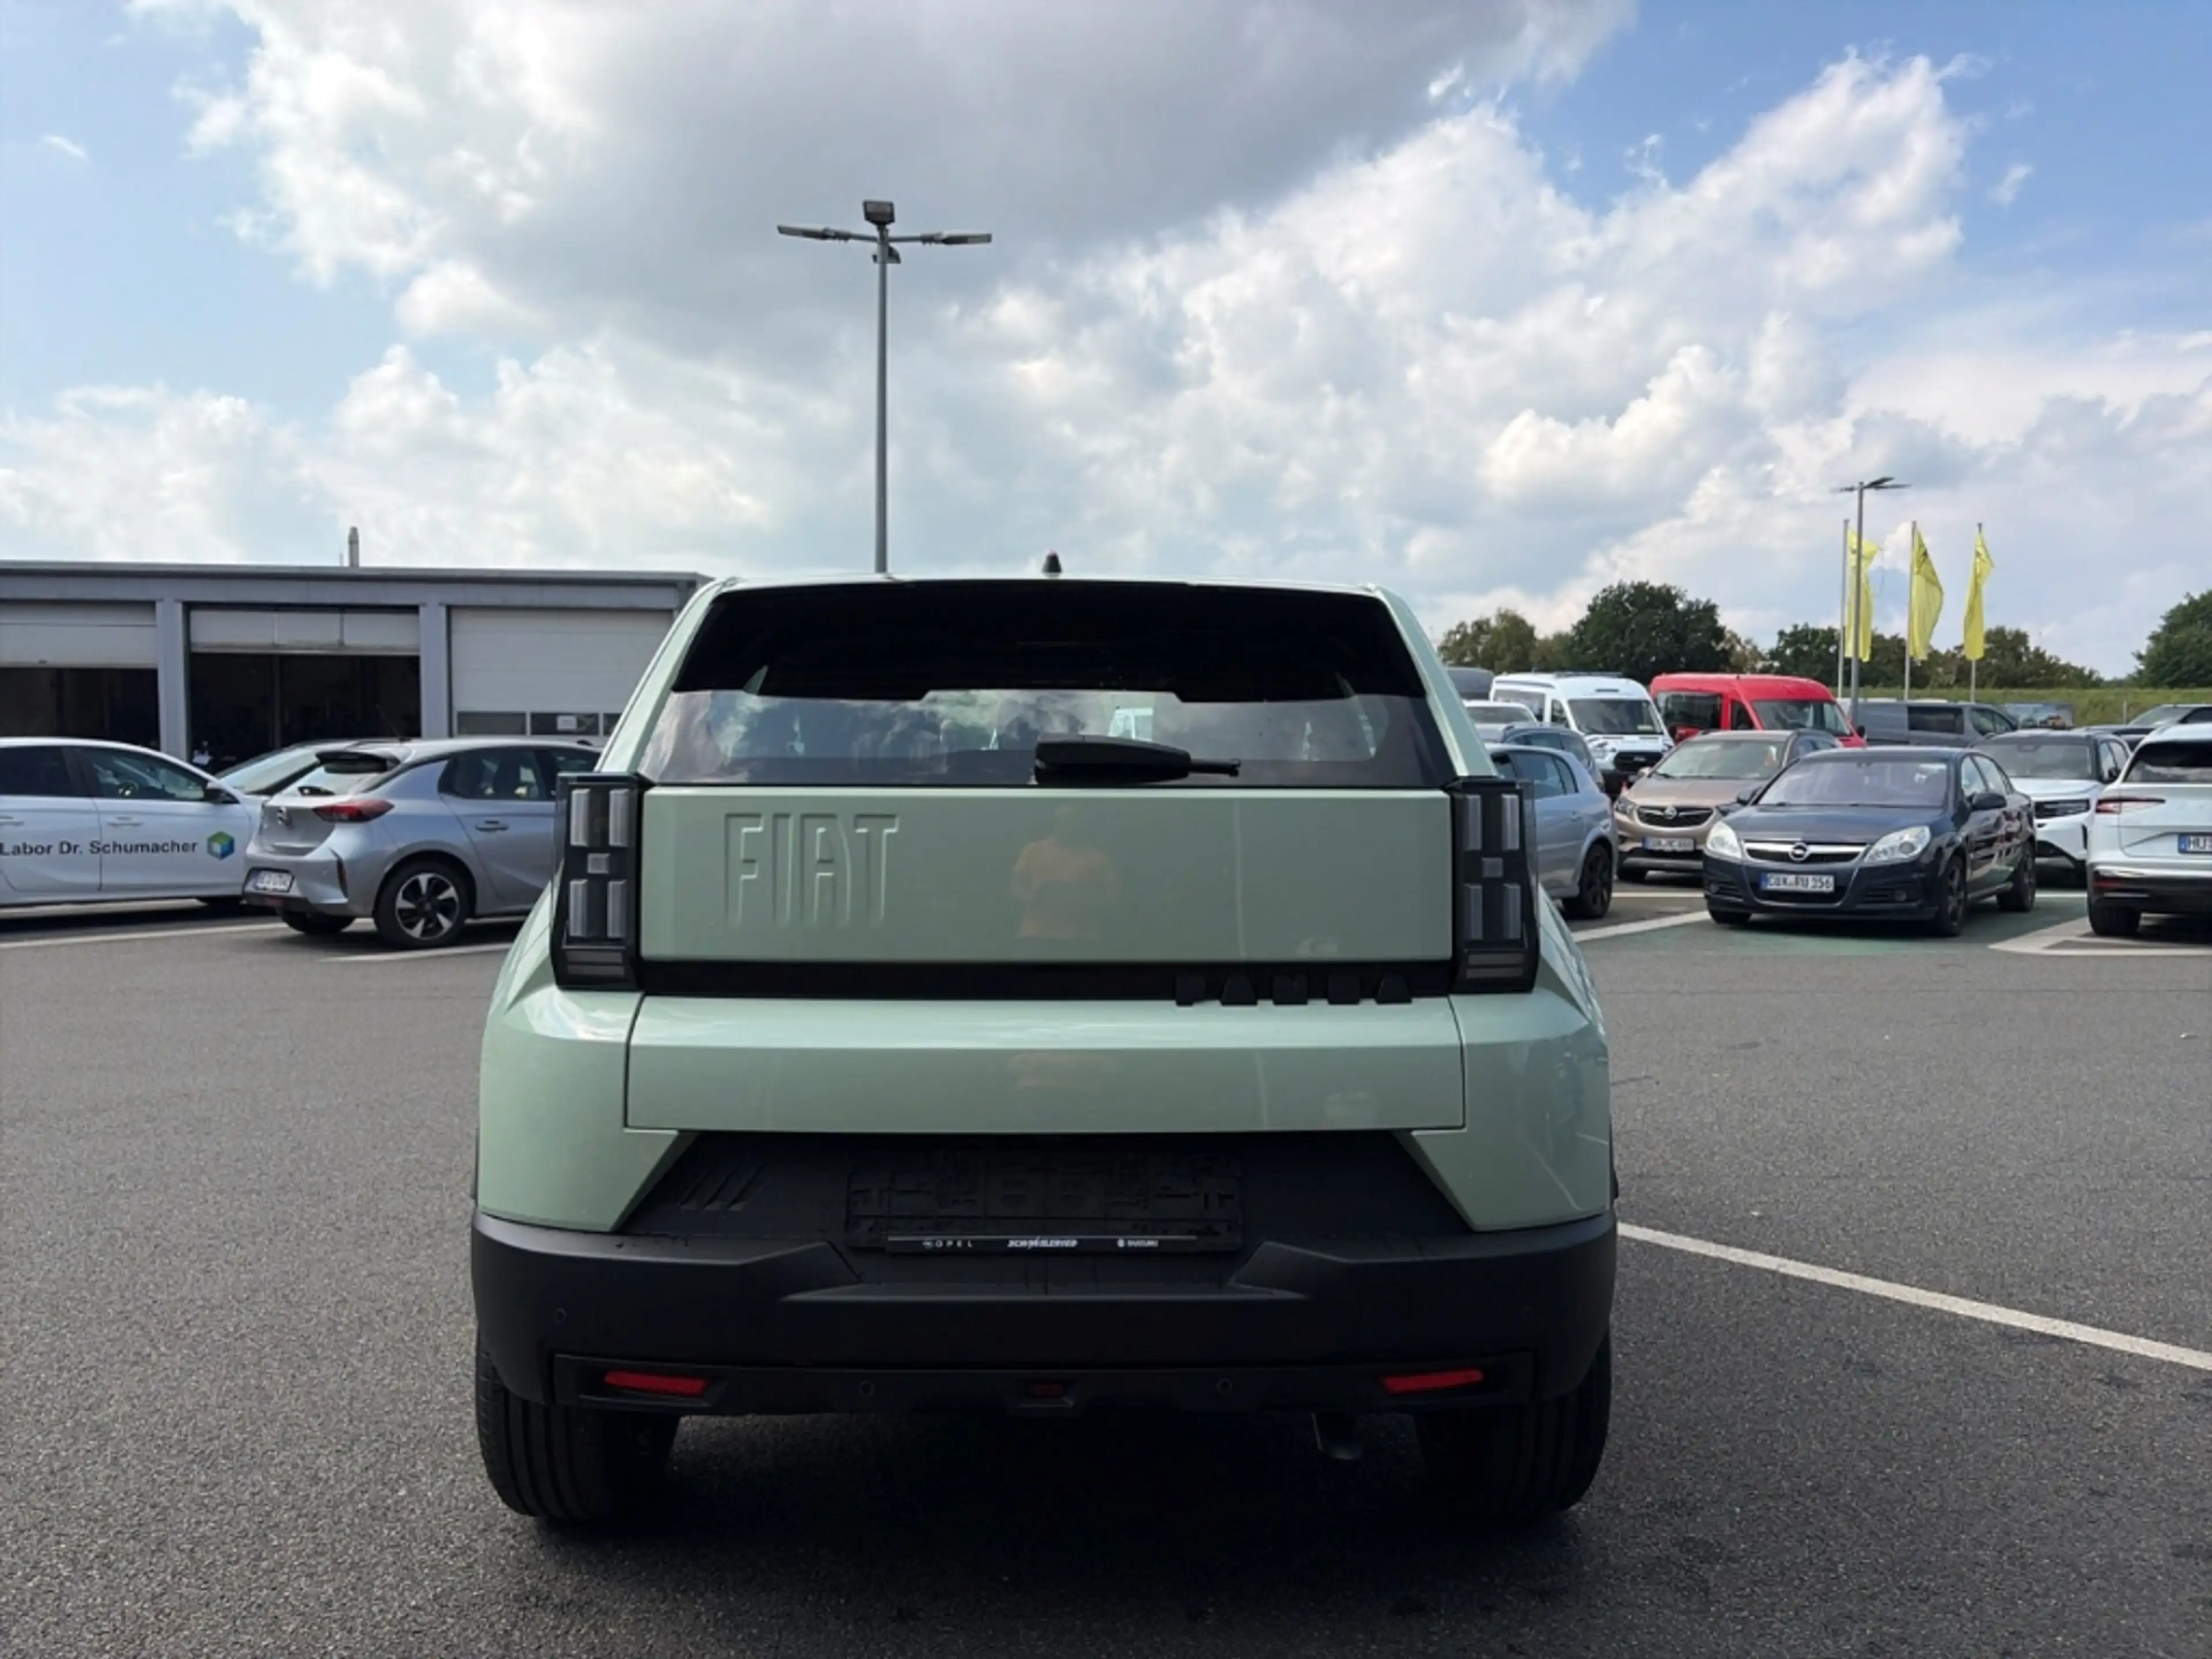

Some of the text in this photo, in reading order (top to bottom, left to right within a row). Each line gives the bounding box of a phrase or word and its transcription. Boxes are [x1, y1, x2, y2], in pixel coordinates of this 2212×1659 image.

[0, 840, 198, 856] Labor Dr. Schumacher
[725, 813, 899, 925] FIAT
